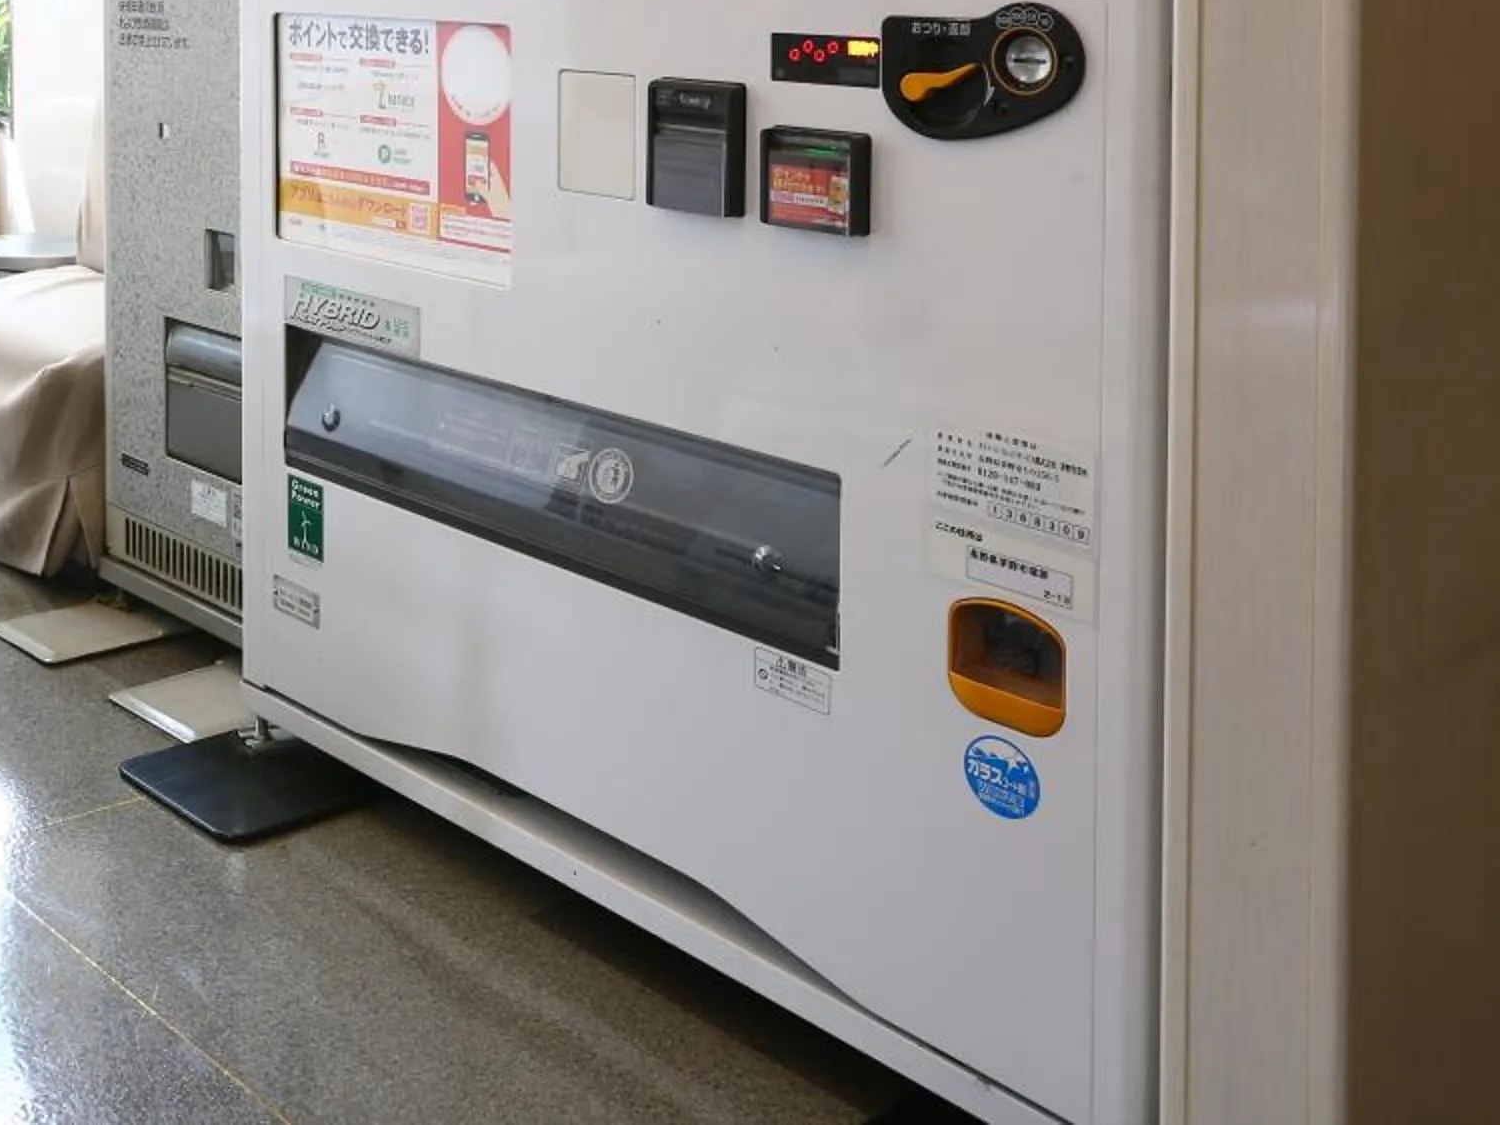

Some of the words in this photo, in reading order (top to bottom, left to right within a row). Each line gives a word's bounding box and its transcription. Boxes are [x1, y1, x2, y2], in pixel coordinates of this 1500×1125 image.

[289, 19, 429, 54] ポイントで交換できる!
[290, 294, 381, 330] HYBRID
